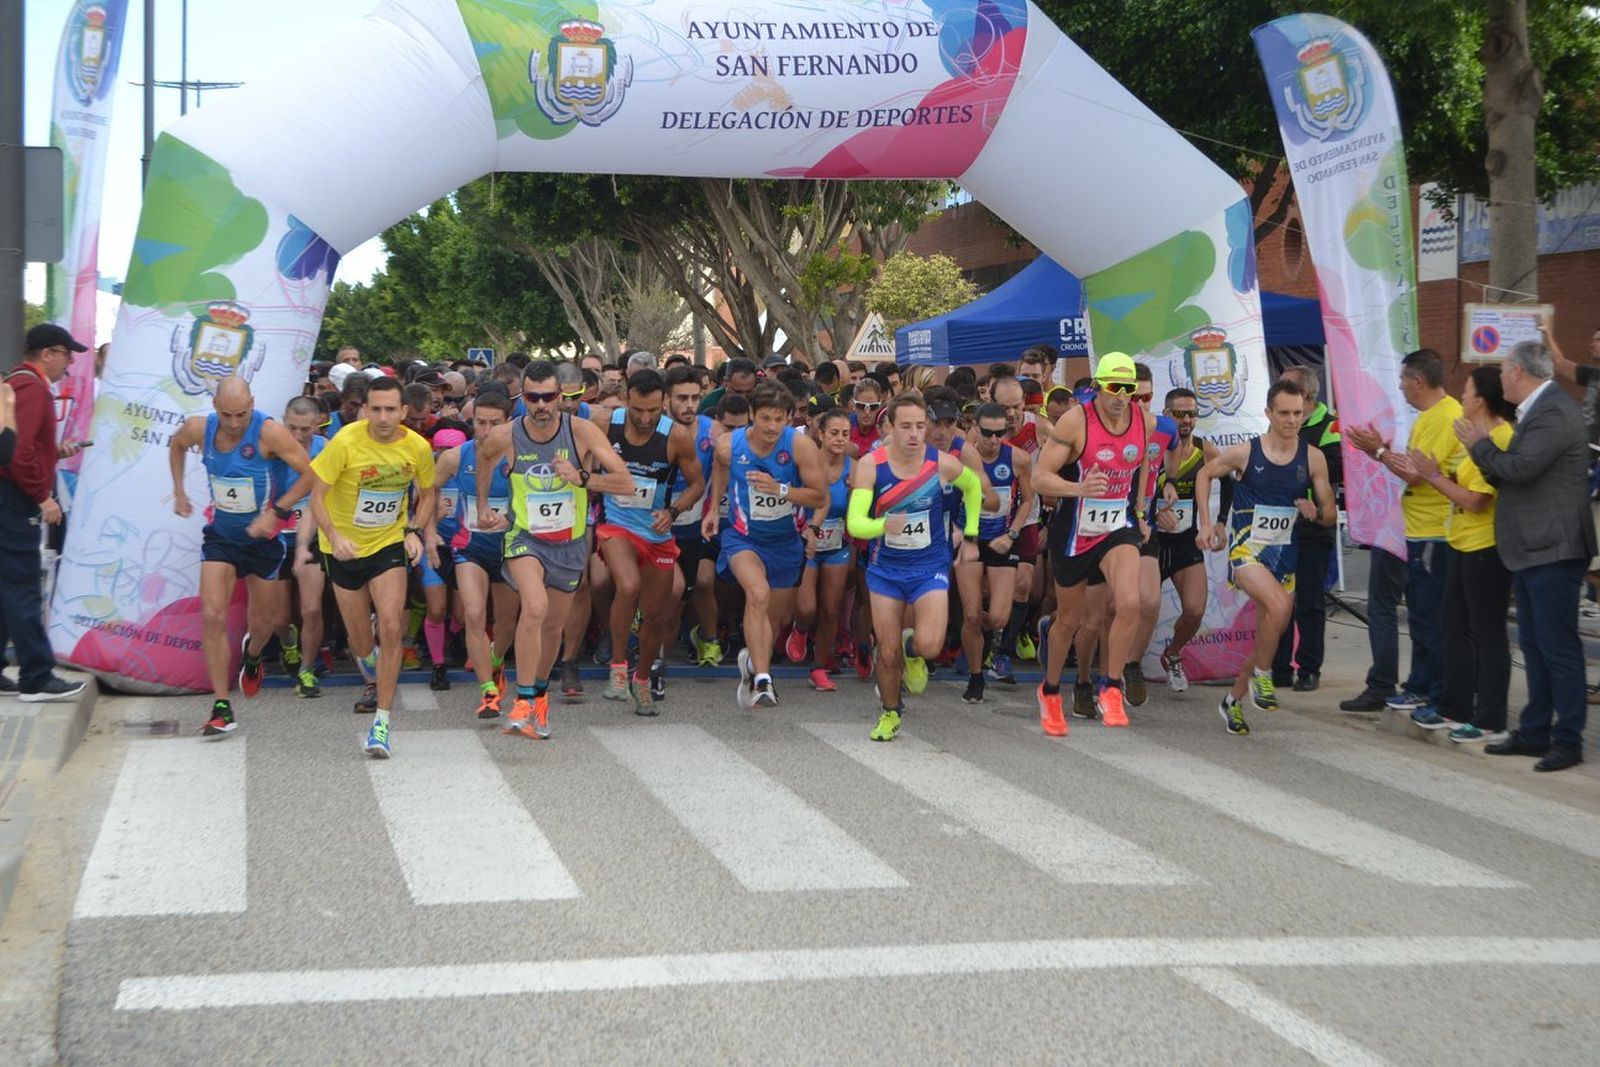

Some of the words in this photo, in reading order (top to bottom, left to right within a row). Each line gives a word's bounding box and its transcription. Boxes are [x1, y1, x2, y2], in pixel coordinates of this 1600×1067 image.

[687, 21, 900, 40] AYUNTAMIENTO
[906, 21, 938, 37] DE
[716, 54, 768, 77] SAN
[777, 52, 918, 77] FERNANDO
[661, 104, 812, 129] DELEGACIÓN
[818, 109, 849, 128] DE
[855, 104, 973, 128] DEPORTES
[130, 427, 162, 446] SAN
[226, 487, 238, 499] 4
[362, 500, 397, 514] 205
[539, 502, 563, 517] 67
[1087, 508, 1121, 524] 117
[1257, 516, 1290, 531] 200
